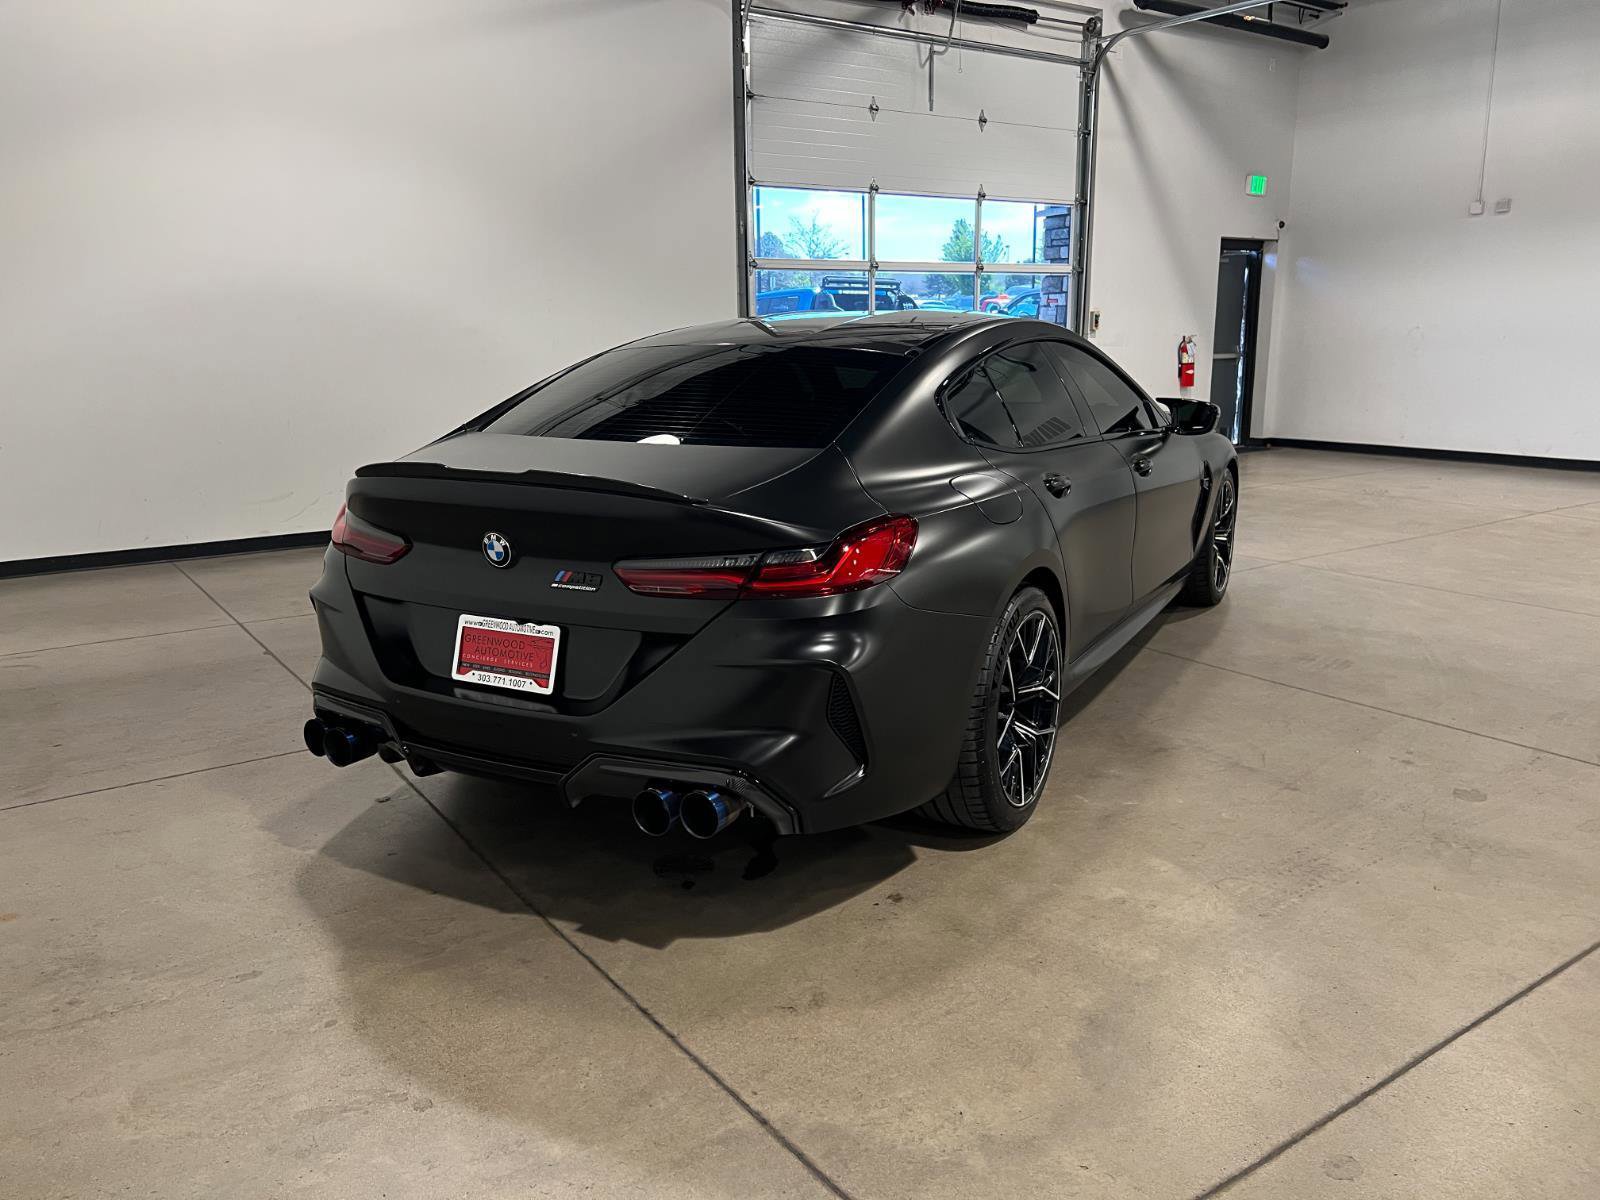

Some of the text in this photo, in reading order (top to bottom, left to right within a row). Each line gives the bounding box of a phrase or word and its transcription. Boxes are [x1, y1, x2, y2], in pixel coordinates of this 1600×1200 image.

[483, 535, 506, 546] BMW
[465, 634, 525, 649] GREENWOOD
[475, 646, 535, 660] AUTOMOTIVE
[477, 674, 527, 688] 303.771.1007
